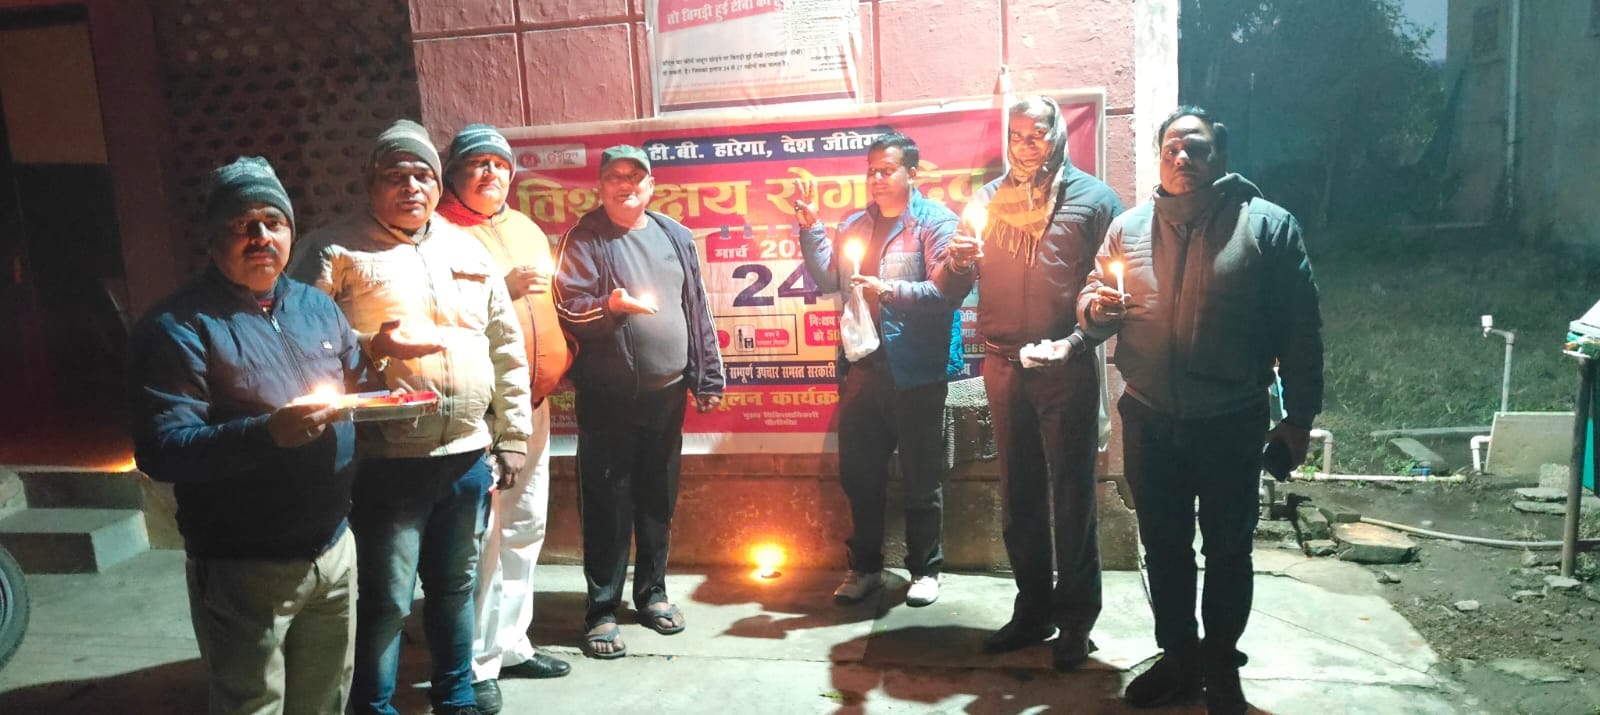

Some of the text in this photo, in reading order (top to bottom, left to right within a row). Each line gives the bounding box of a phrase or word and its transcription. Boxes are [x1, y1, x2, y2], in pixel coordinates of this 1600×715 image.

[649, 131, 880, 161] टी.बी. हारेगा, देश जीतेग
[715, 239, 803, 258] मार्च 20
[732, 263, 823, 307] 24
[756, 365, 779, 379] उपचार
[781, 364, 805, 379] समस्त
[807, 361, 836, 378] सरकारी
[770, 387, 840, 406] कार्यक्र
